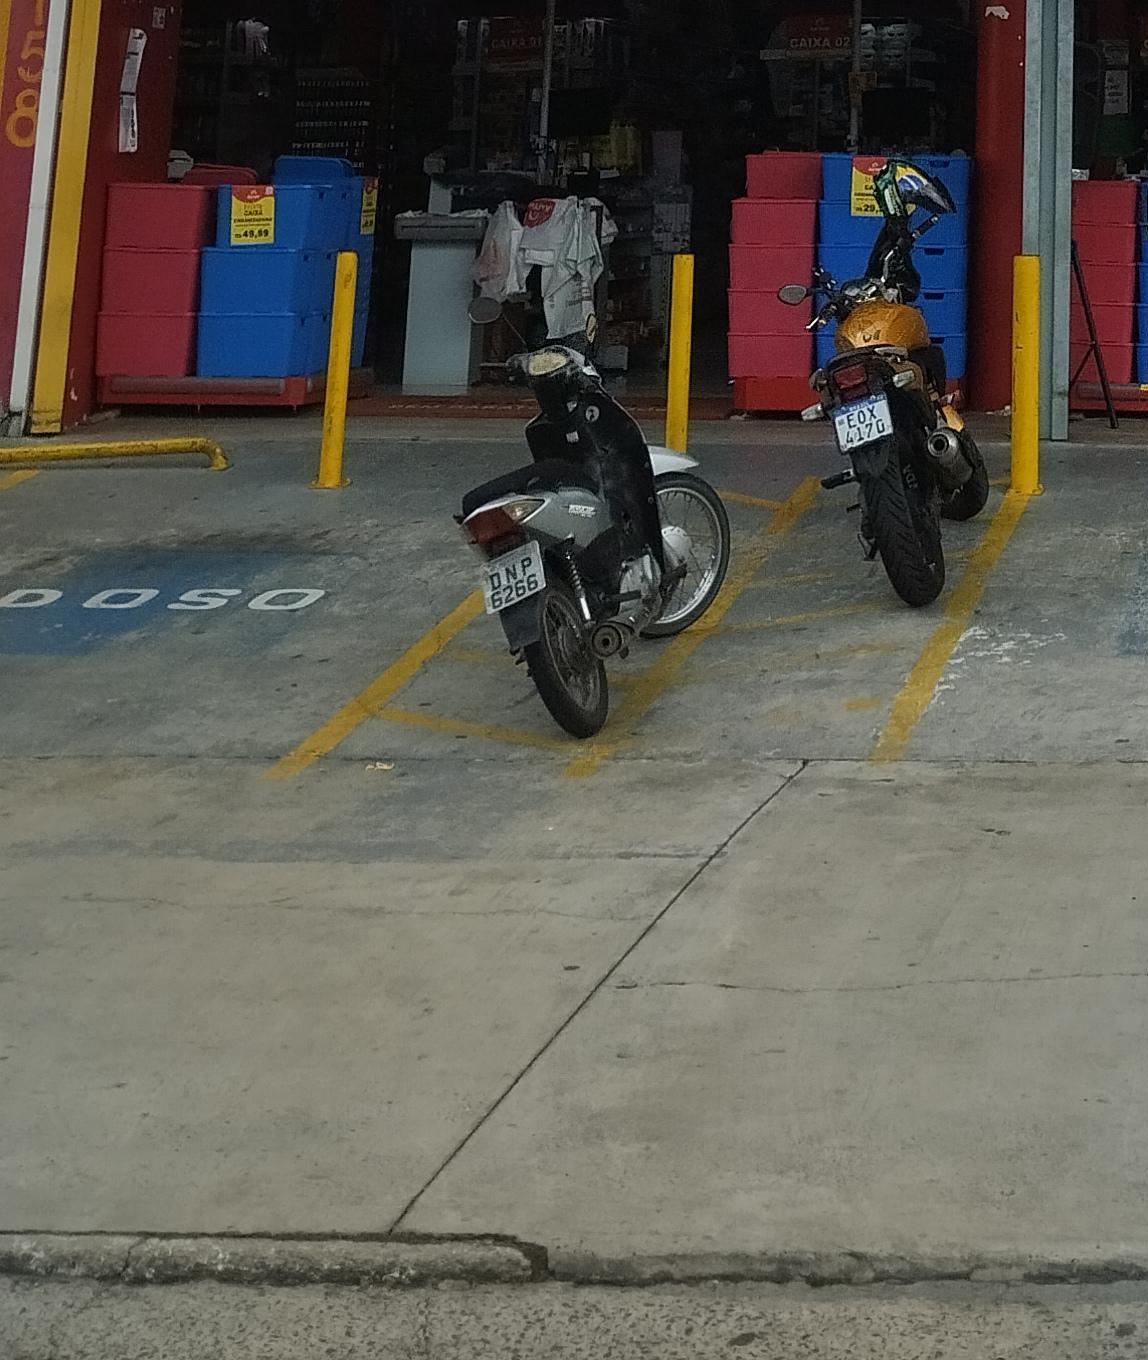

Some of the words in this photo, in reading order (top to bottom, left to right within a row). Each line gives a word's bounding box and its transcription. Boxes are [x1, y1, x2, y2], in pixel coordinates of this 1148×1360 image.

[789, 37, 831, 49] CAIXA
[846, 405, 877, 429] EOX
[489, 556, 532, 591] DNP
[490, 573, 539, 610] 6266
